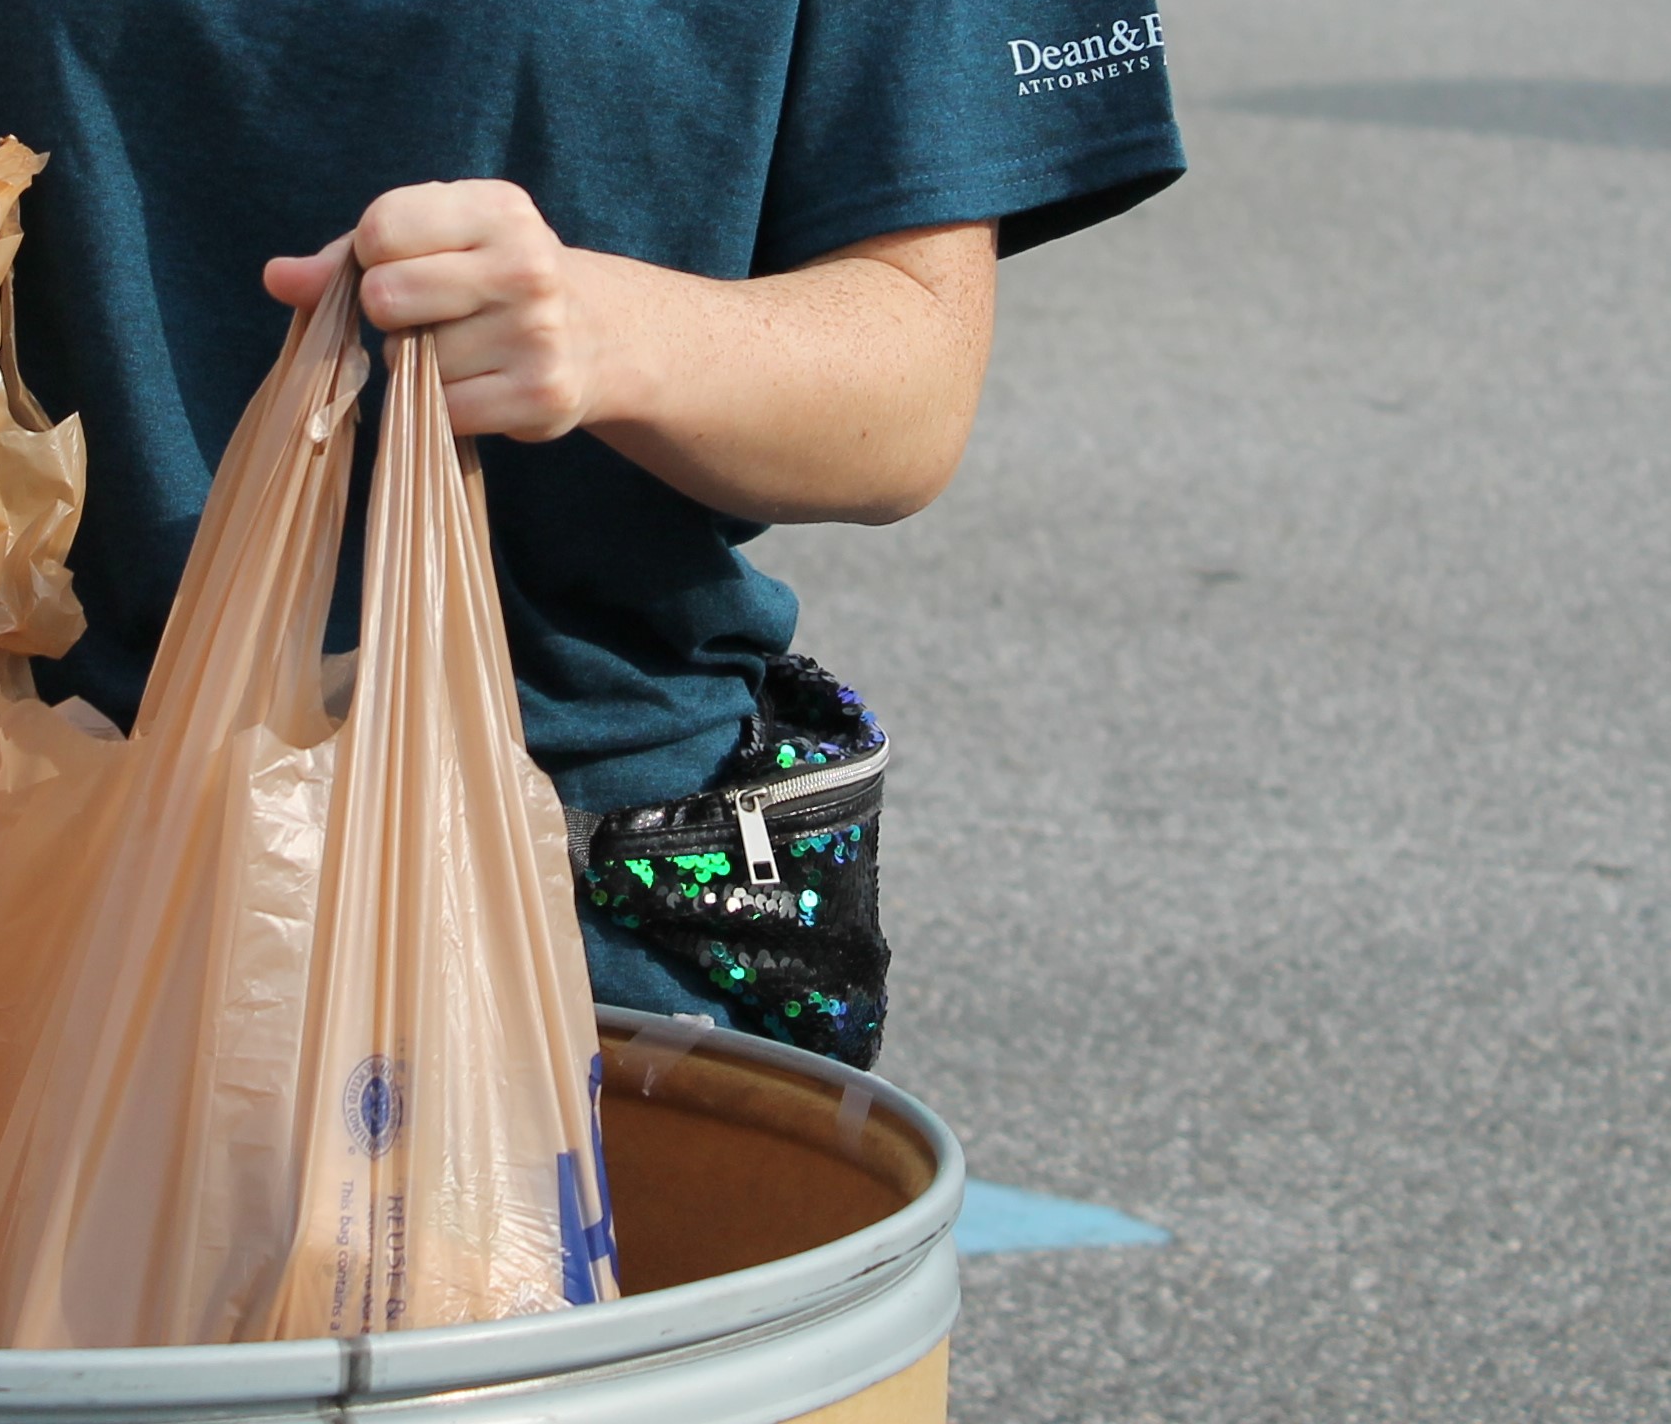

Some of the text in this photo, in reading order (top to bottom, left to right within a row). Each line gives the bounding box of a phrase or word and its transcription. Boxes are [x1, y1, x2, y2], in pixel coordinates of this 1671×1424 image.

[1017, 55, 1151, 96] ATTORNEYS
[341, 1179, 354, 1211] This
[336, 1215, 353, 1246] bag
[332, 1249, 349, 1317] contains
